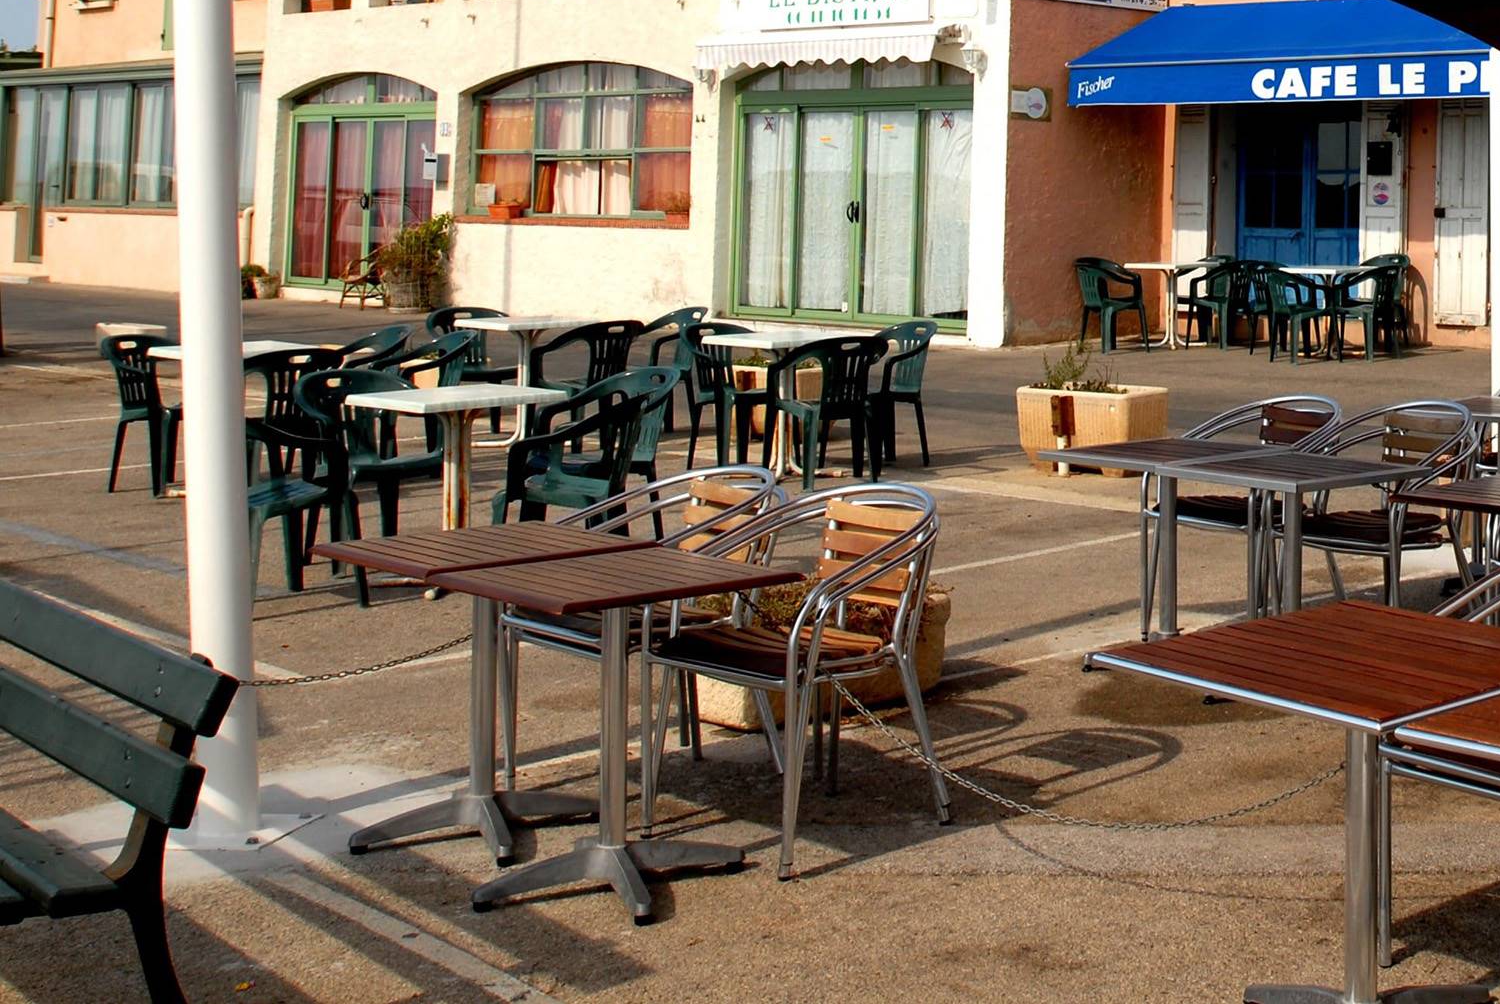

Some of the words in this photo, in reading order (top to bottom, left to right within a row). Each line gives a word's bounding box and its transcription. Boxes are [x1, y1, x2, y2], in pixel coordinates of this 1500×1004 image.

[1077, 75, 1115, 99] Fischer
[1251, 65, 1357, 100] CAFE
[1378, 62, 1426, 95] LE
